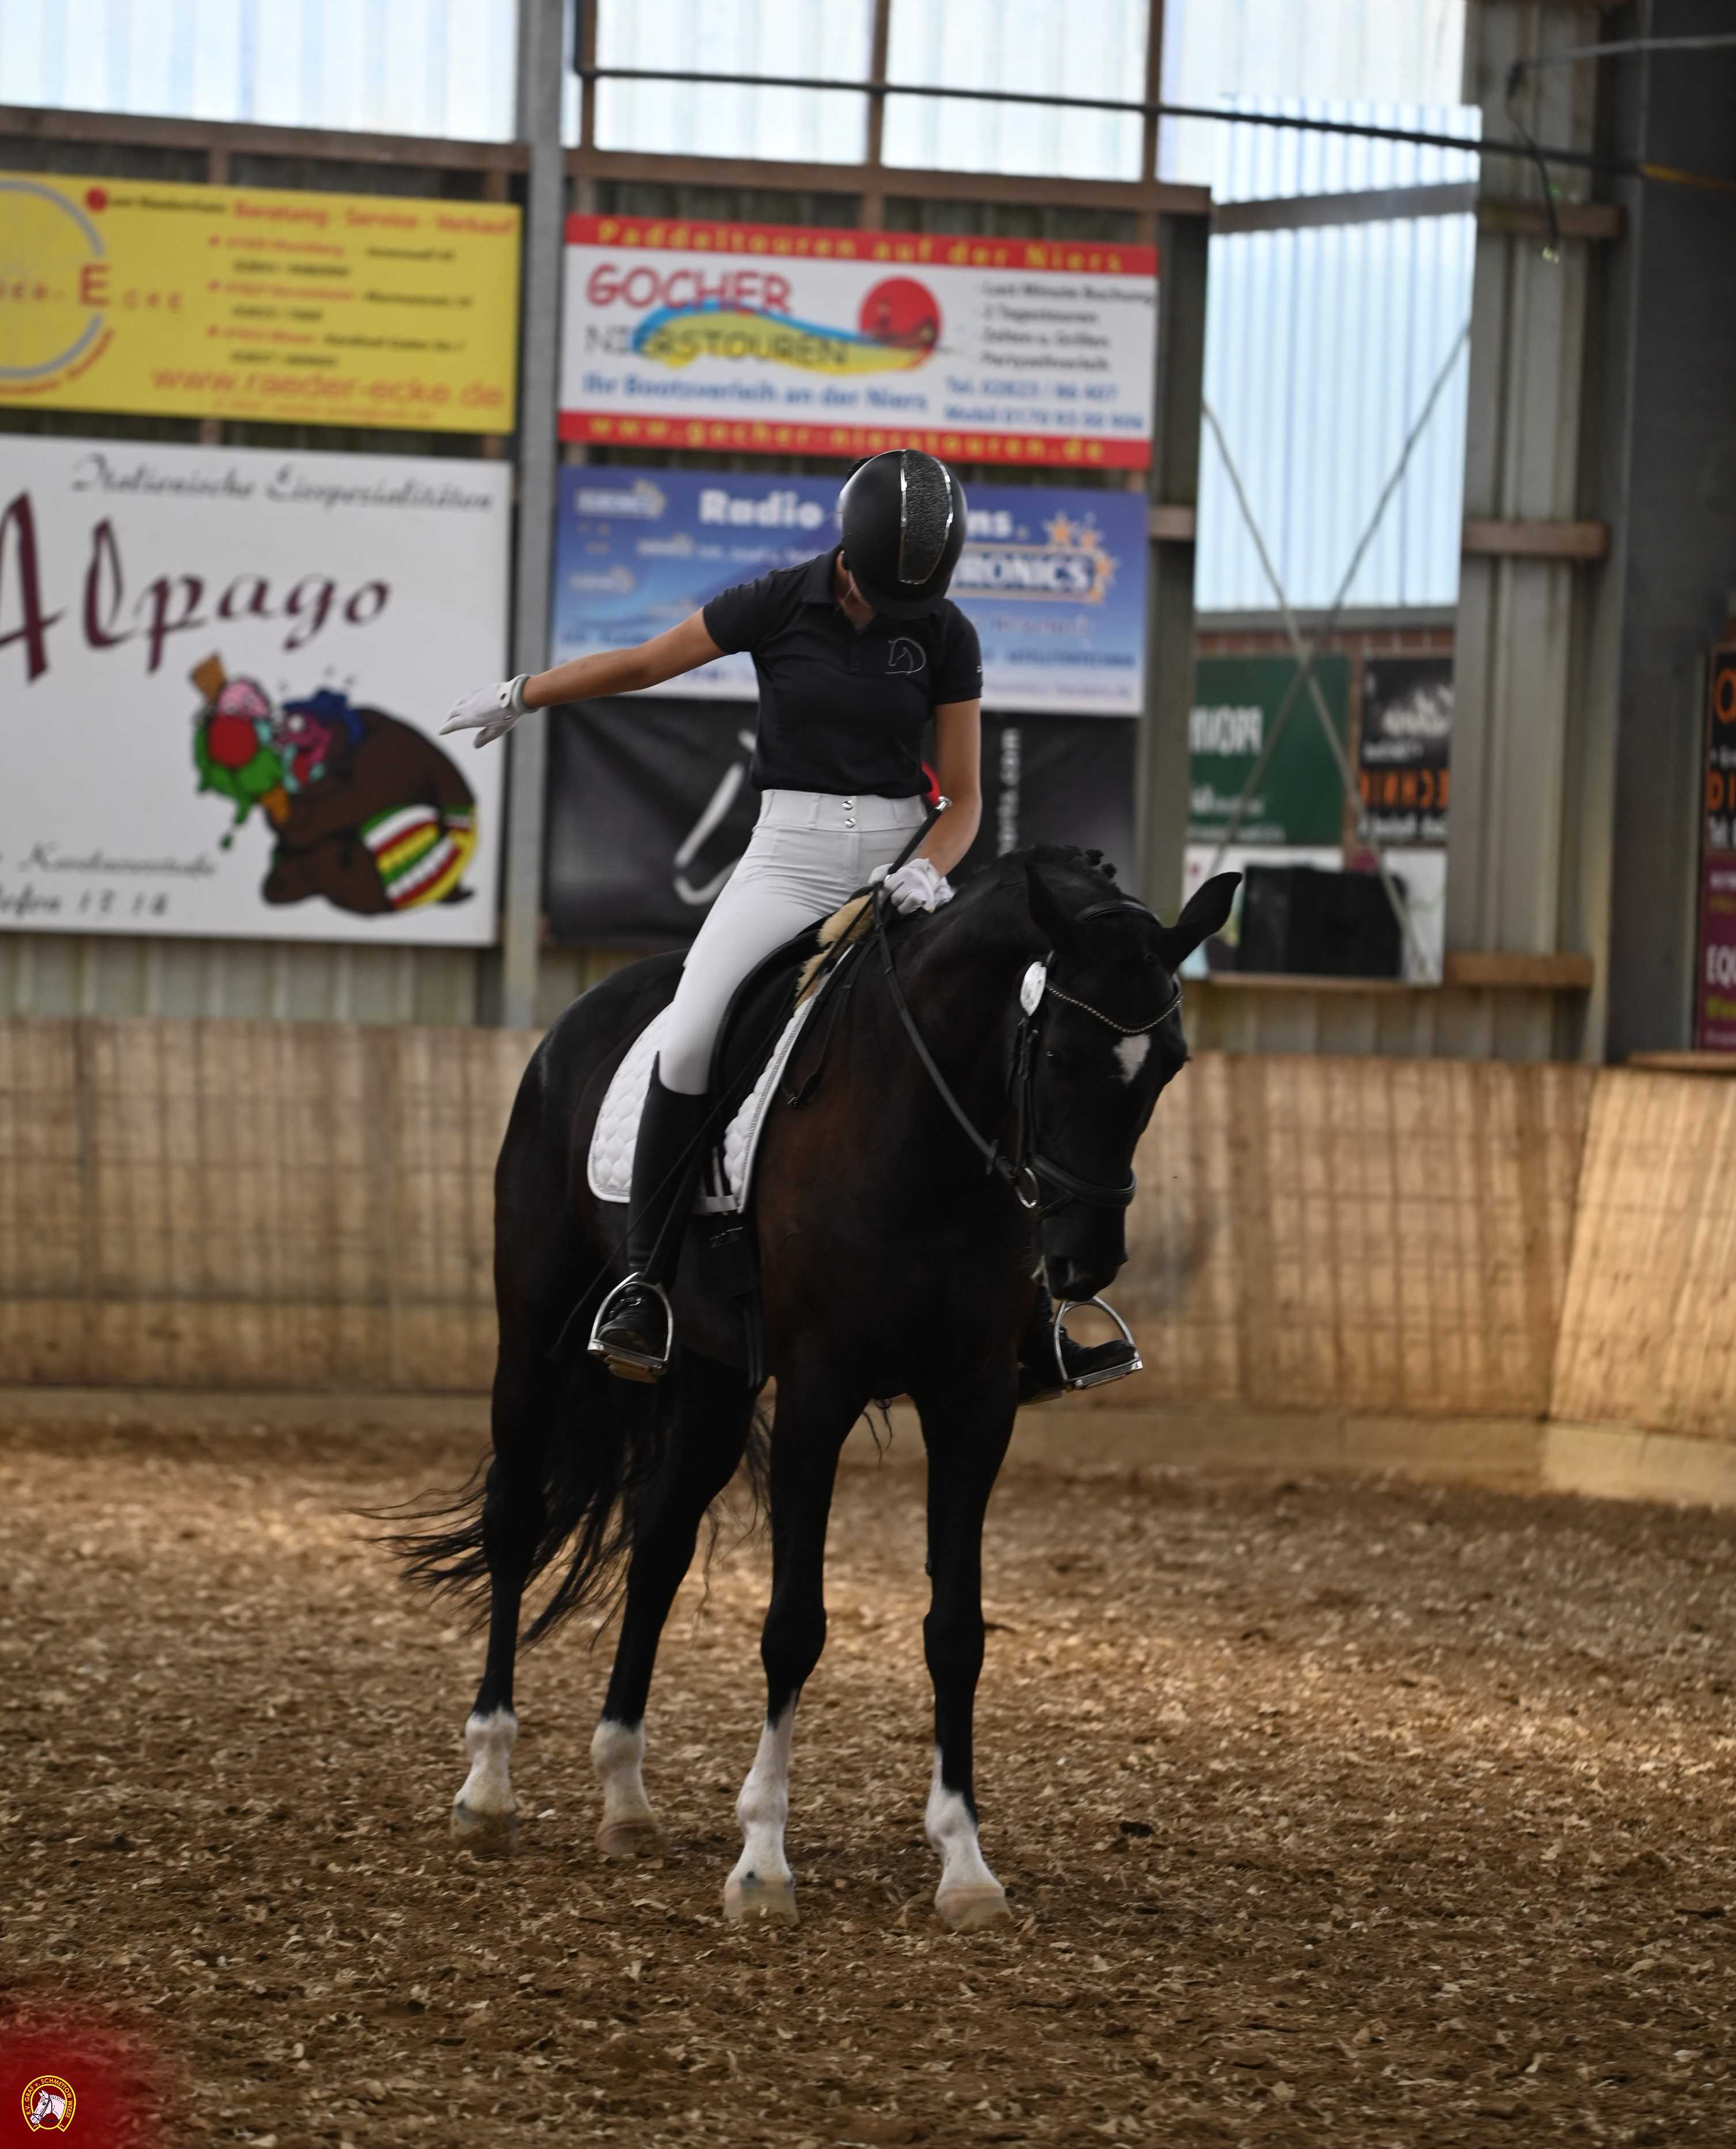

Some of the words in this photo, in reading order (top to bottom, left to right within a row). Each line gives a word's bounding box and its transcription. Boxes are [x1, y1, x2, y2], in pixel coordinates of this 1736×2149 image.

[597, 219, 856, 258] Paddeltouren
[873, 235, 933, 263] auf
[948, 239, 1008, 267] der
[1026, 244, 1122, 273] Niers
[586, 263, 793, 316] GOCHER
[585, 324, 848, 367] NIERSTOUREN
[867, 385, 928, 410] Niers
[699, 488, 824, 531] Radio
[0, 489, 391, 684] Alpago
[957, 554, 1091, 589] RONICS
[998, 728, 1021, 852] orts.com
